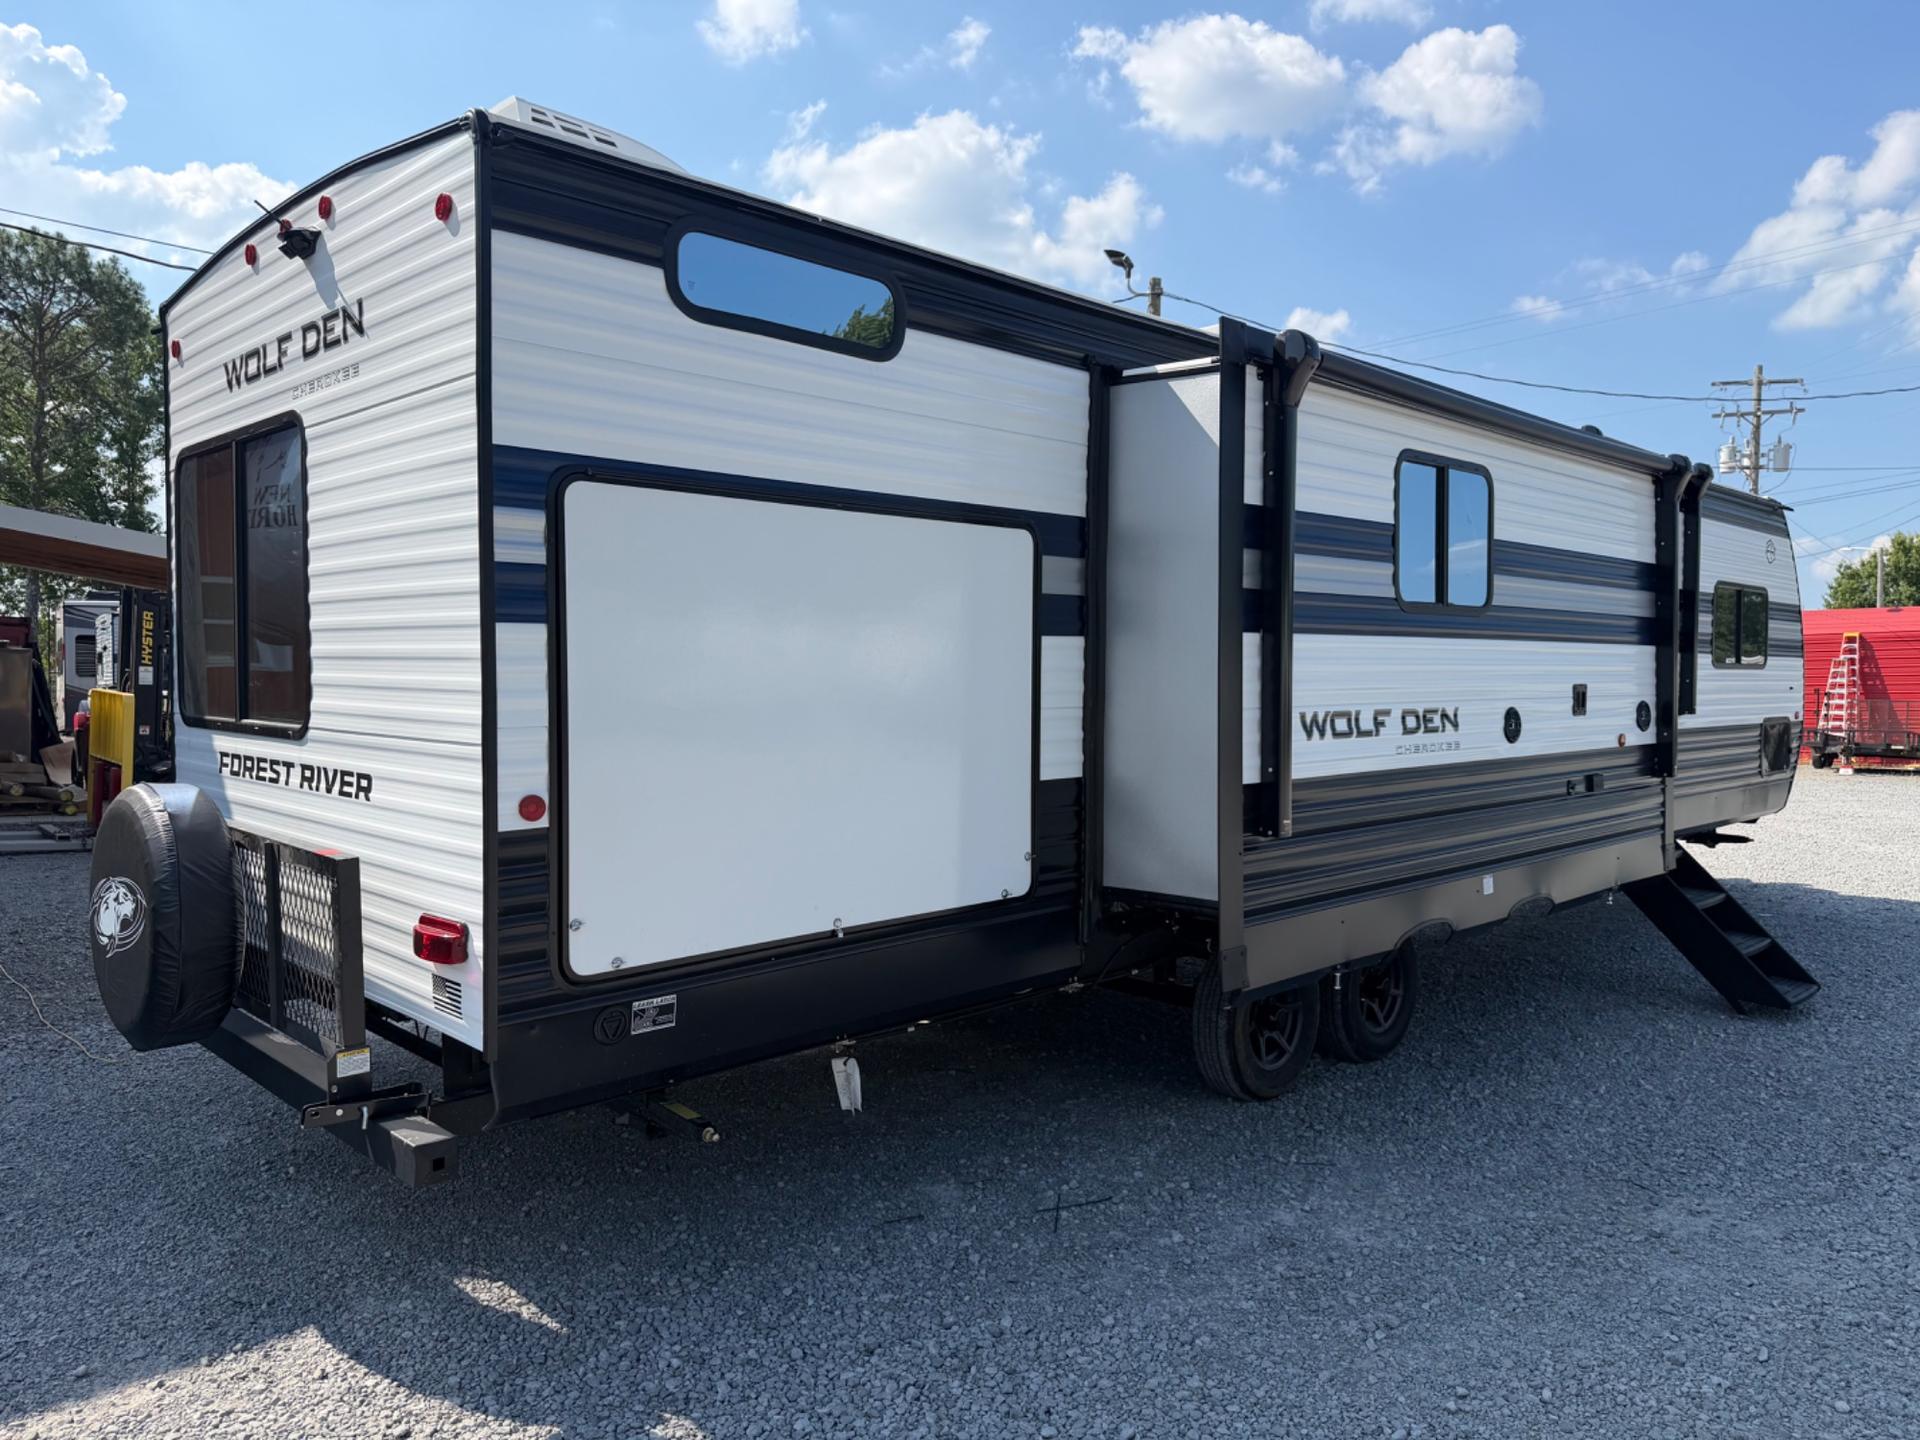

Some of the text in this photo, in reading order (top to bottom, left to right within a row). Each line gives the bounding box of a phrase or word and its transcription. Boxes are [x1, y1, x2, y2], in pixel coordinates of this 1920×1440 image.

[223, 298, 365, 393] WOLF DEN
[141, 611, 154, 665] HYSTER
[1299, 706, 1459, 741] WOLF DEN
[218, 751, 373, 802] FOREST RIVER
